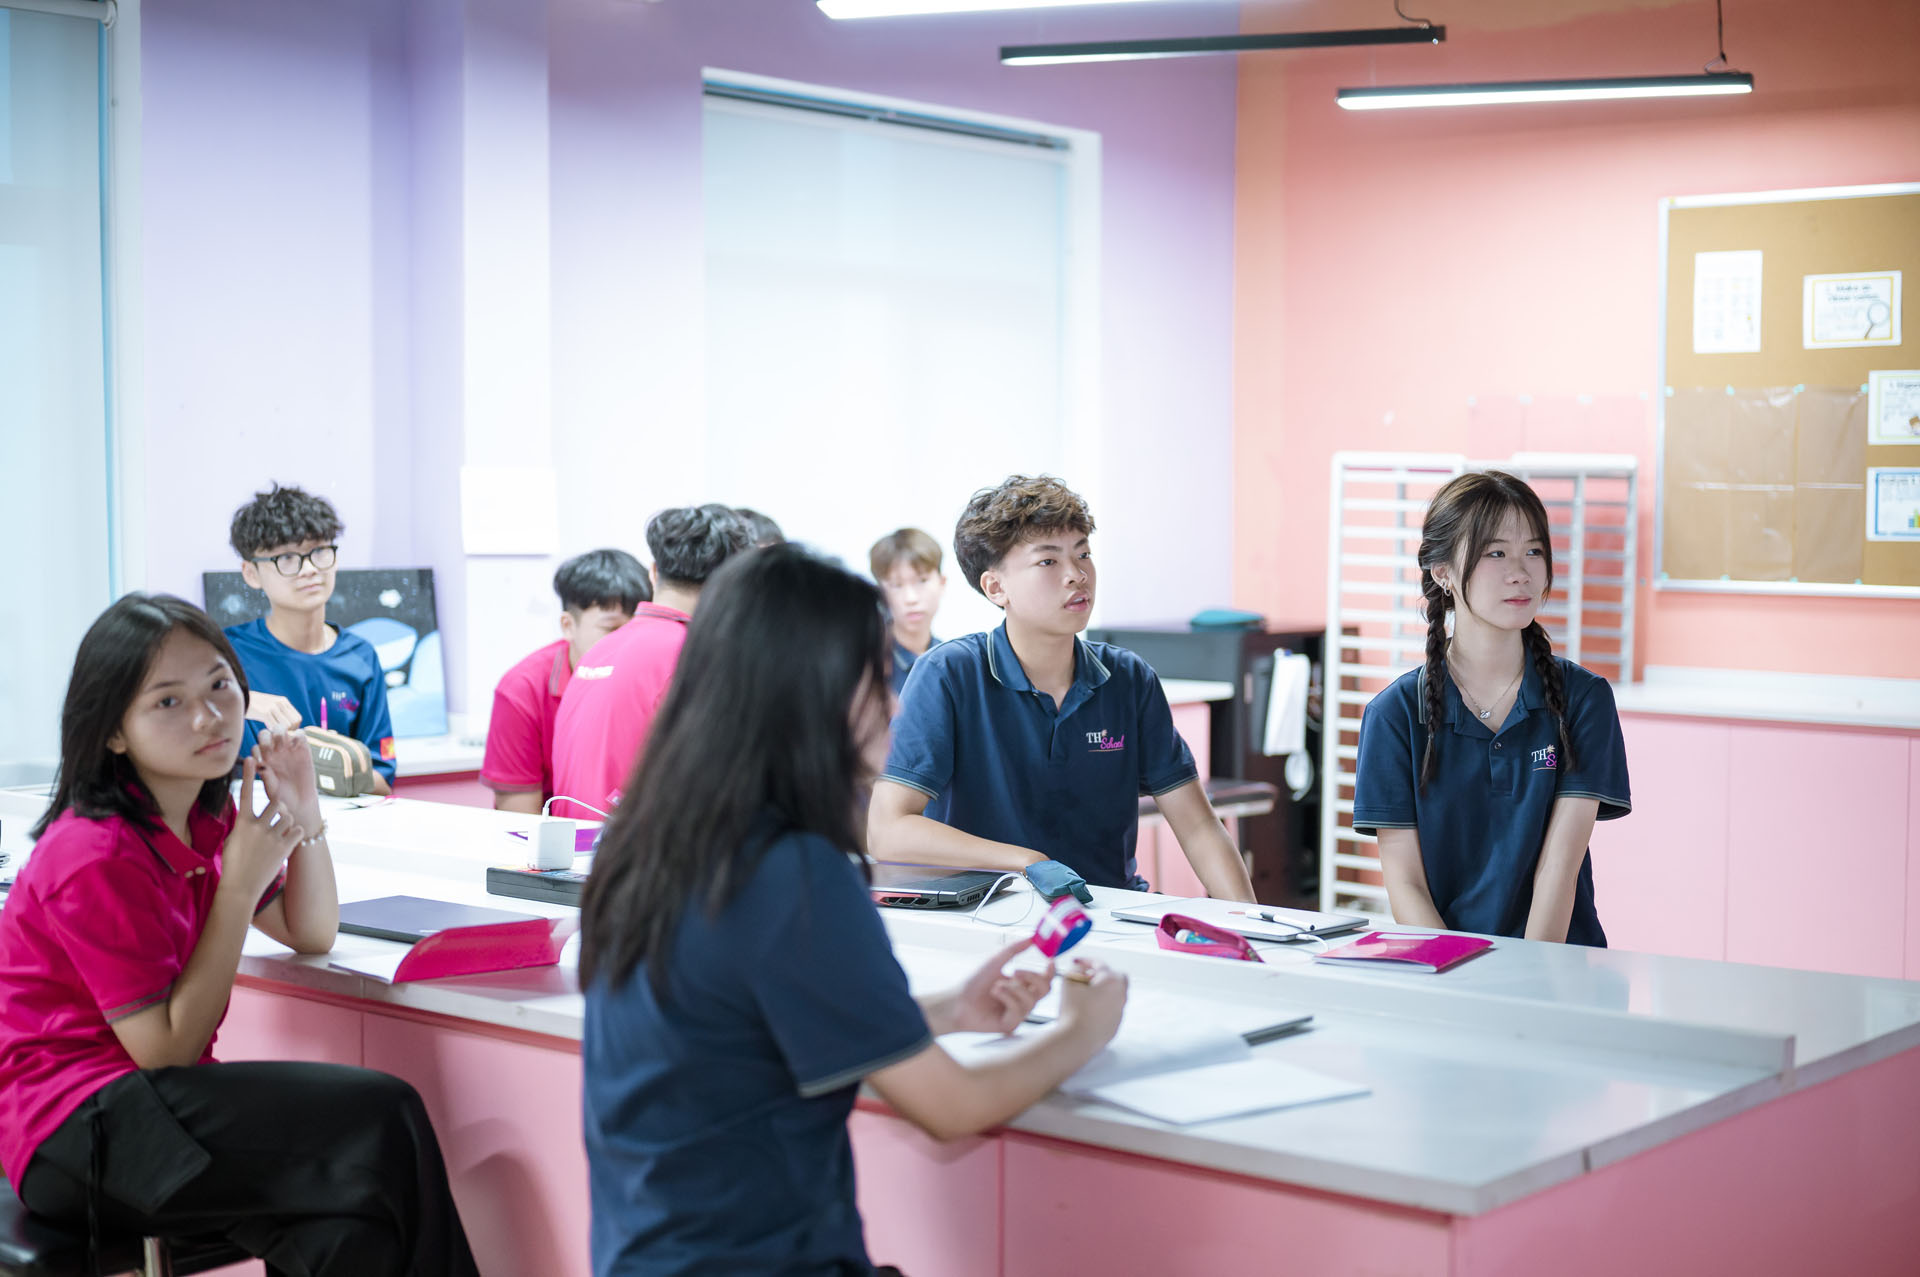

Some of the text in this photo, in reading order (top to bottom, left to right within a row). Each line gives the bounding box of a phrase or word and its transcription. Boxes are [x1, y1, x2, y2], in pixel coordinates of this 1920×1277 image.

[1086, 732, 1102, 743] TH
[1100, 736, 1125, 749] School
[1531, 748, 1547, 762] TH
